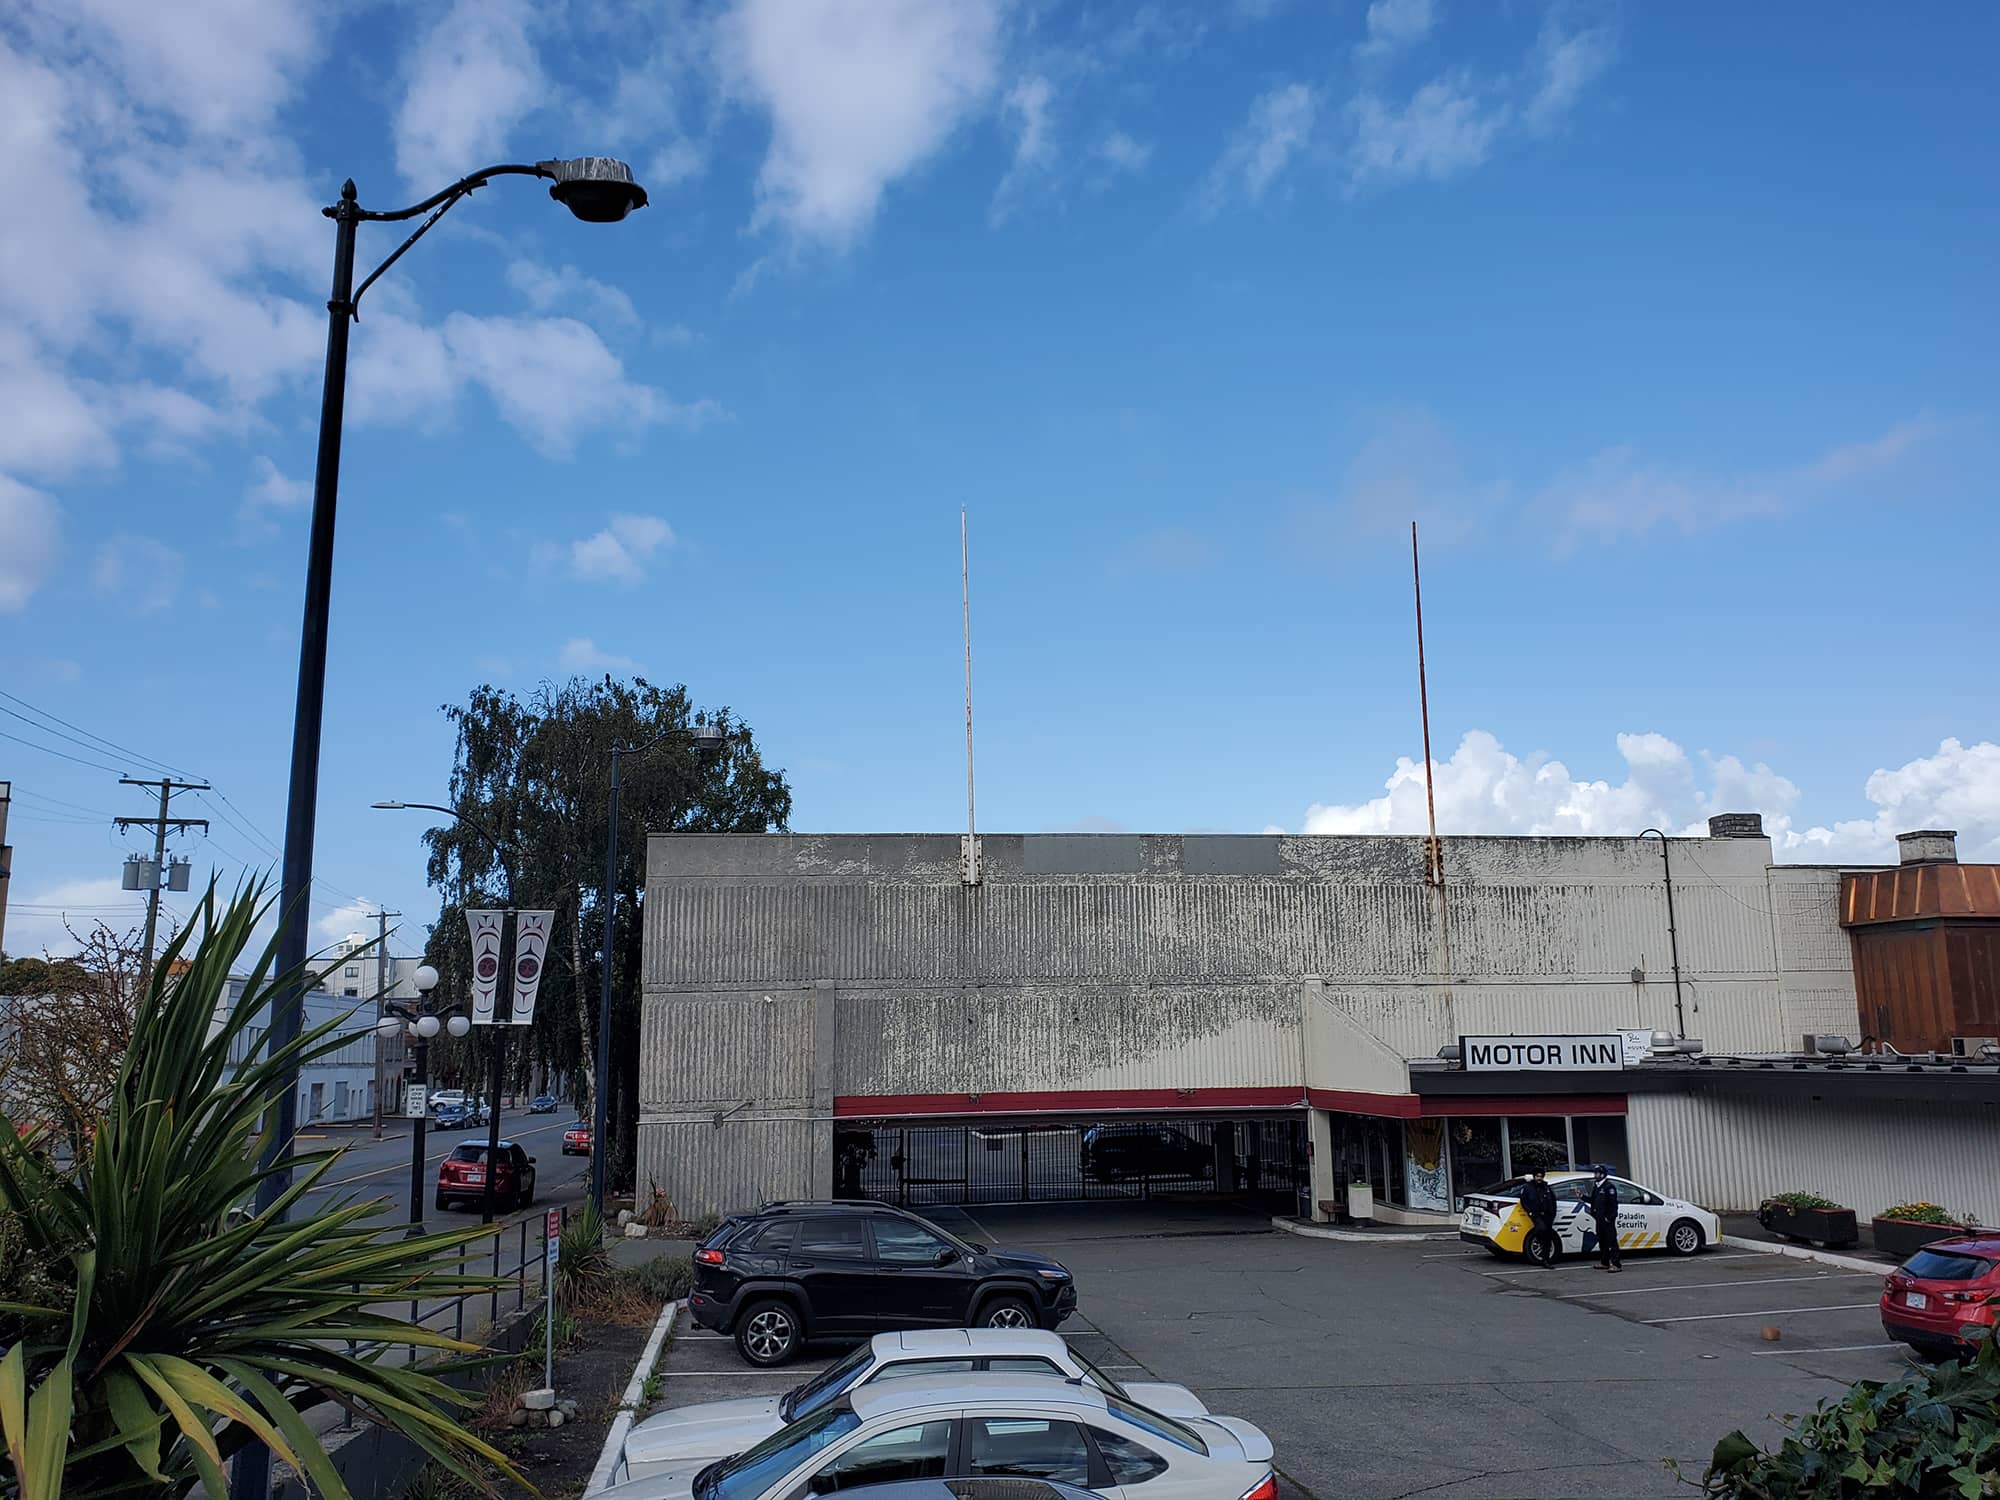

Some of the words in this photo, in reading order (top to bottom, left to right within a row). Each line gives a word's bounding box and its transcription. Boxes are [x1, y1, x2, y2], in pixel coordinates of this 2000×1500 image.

[1470, 1044, 1562, 1065] MOTOR
[1572, 1043, 1617, 1064] INN
[1618, 1212, 1646, 1220] Paladin
[1616, 1220, 1648, 1230] Security
